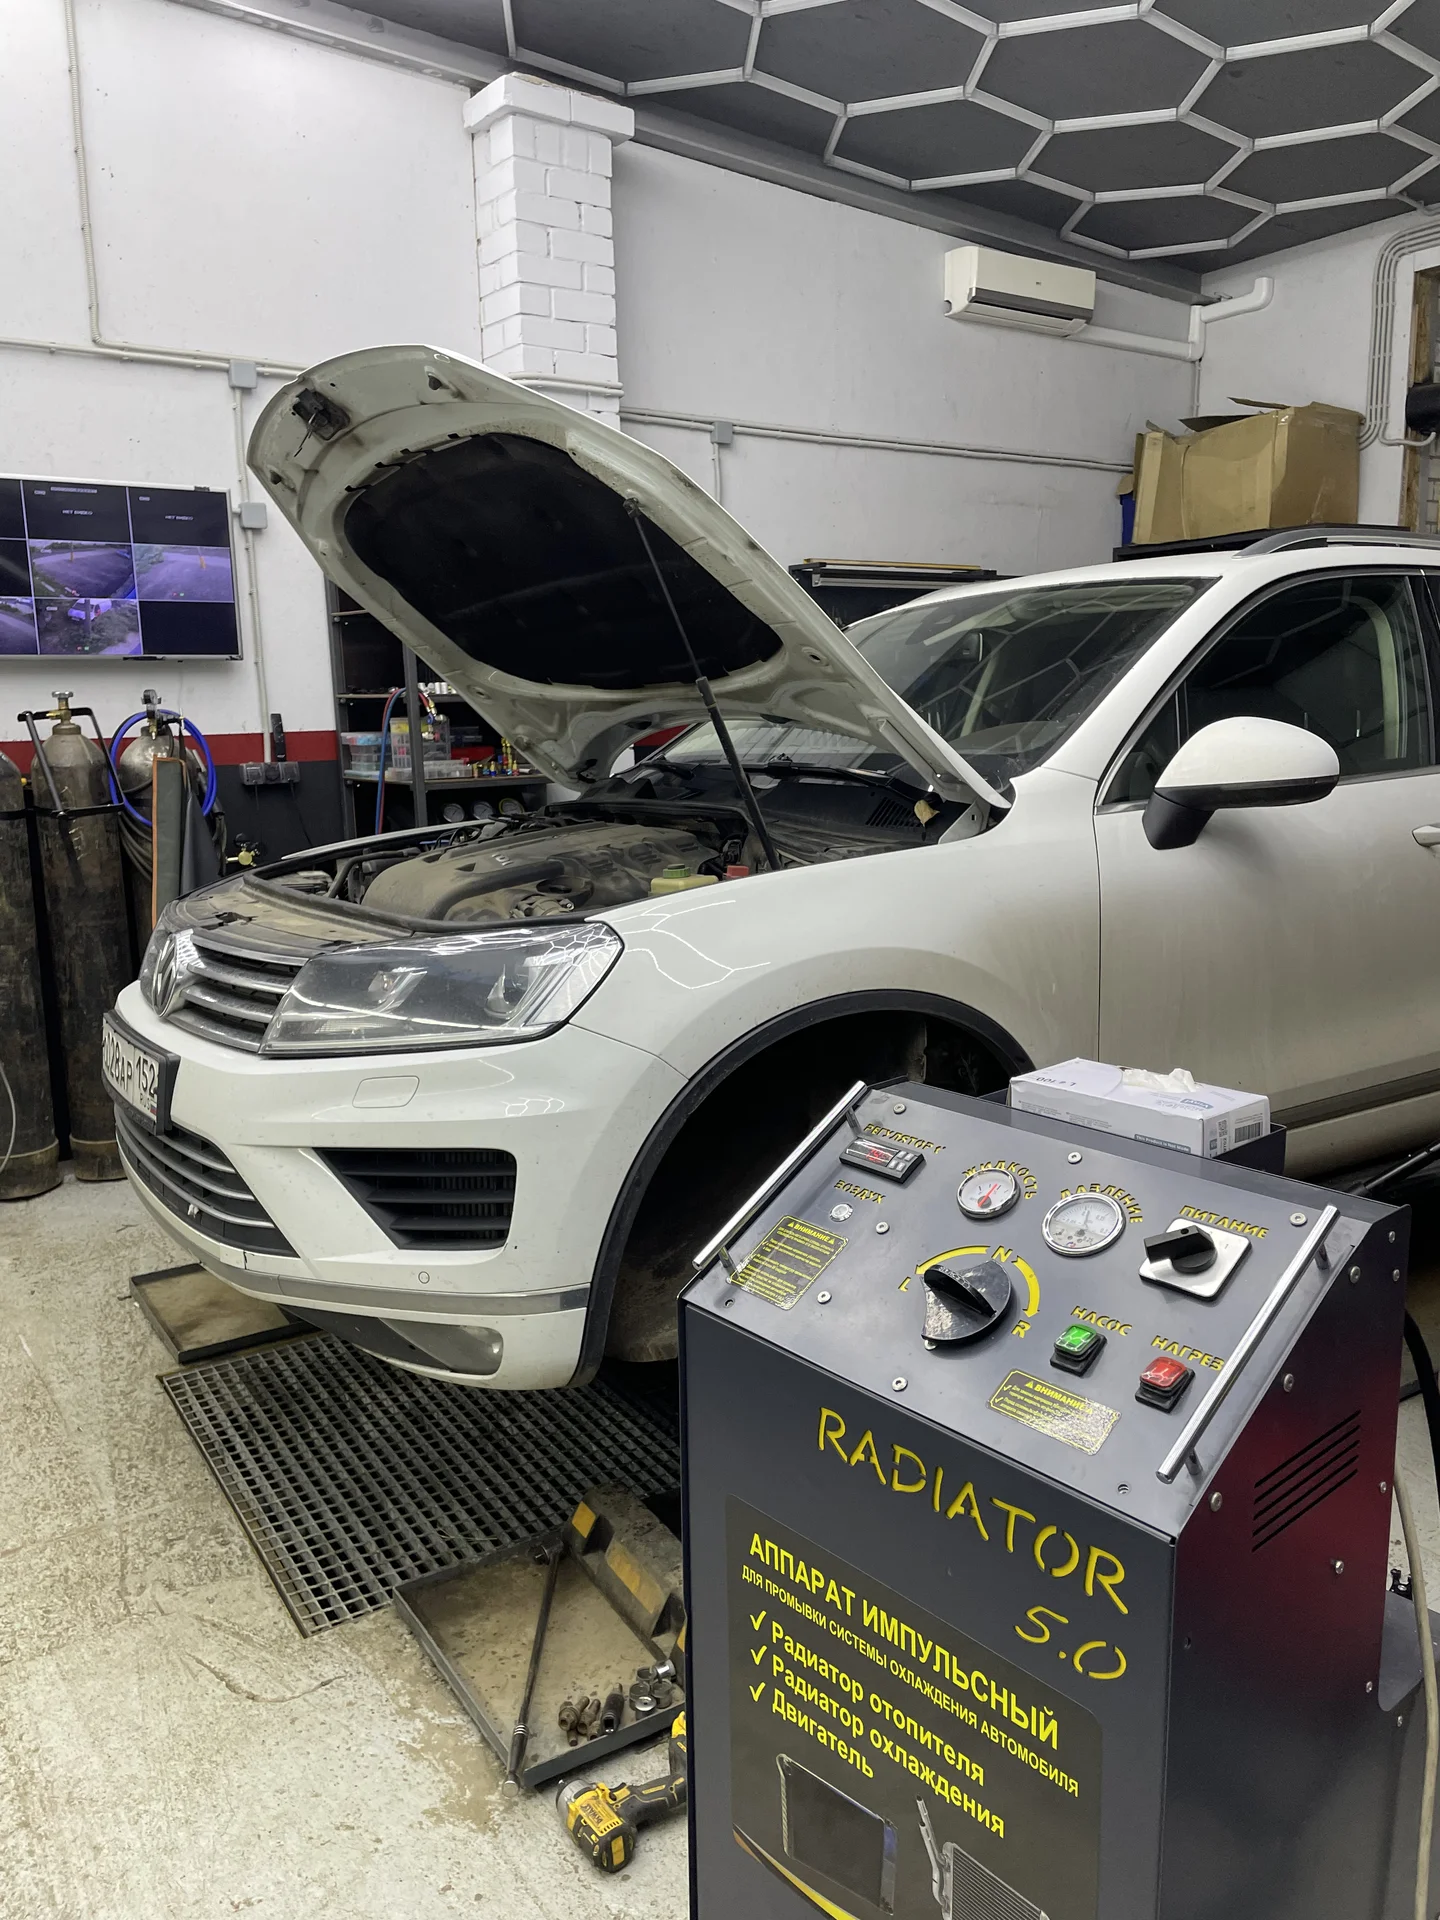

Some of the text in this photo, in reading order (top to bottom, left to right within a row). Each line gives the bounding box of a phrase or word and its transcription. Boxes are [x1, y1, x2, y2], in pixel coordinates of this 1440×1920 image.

[136, 1055, 157, 1098] 152
[139, 1092, 151, 1111] RUS
[834, 1179, 886, 1204] ВОЗДУХ
[962, 1160, 1038, 1199] ЖИДКОСТЬ
[1060, 1183, 1143, 1224] ДАВЛЕНИЕ
[1179, 1205, 1269, 1239] ПИТАНИЕ
[991, 1245, 1013, 1263] N
[898, 1276, 911, 1292] L
[1011, 1320, 1032, 1339] R
[1070, 1305, 1133, 1337] НАСОС
[1151, 1335, 1225, 1372] НАГРЕВ
[818, 1407, 1129, 1615] RADIATOR
[750, 1532, 1058, 1750] АППАРАТ ИМПУЛЬСНЫЙ
[1014, 1605, 1128, 1680] 5.0
[741, 1564, 1080, 1798] ДЛЯ ПРОМЫВКИ СИСТЕМЫ ОХЛАЖДЕНИЯ АВТОМОБИЛЯ
[772, 1620, 985, 1787] Радиатор отопителя
[772, 1687, 874, 1778] Двигатель
[772, 1654, 1005, 1839] Радиатор охлаждения
